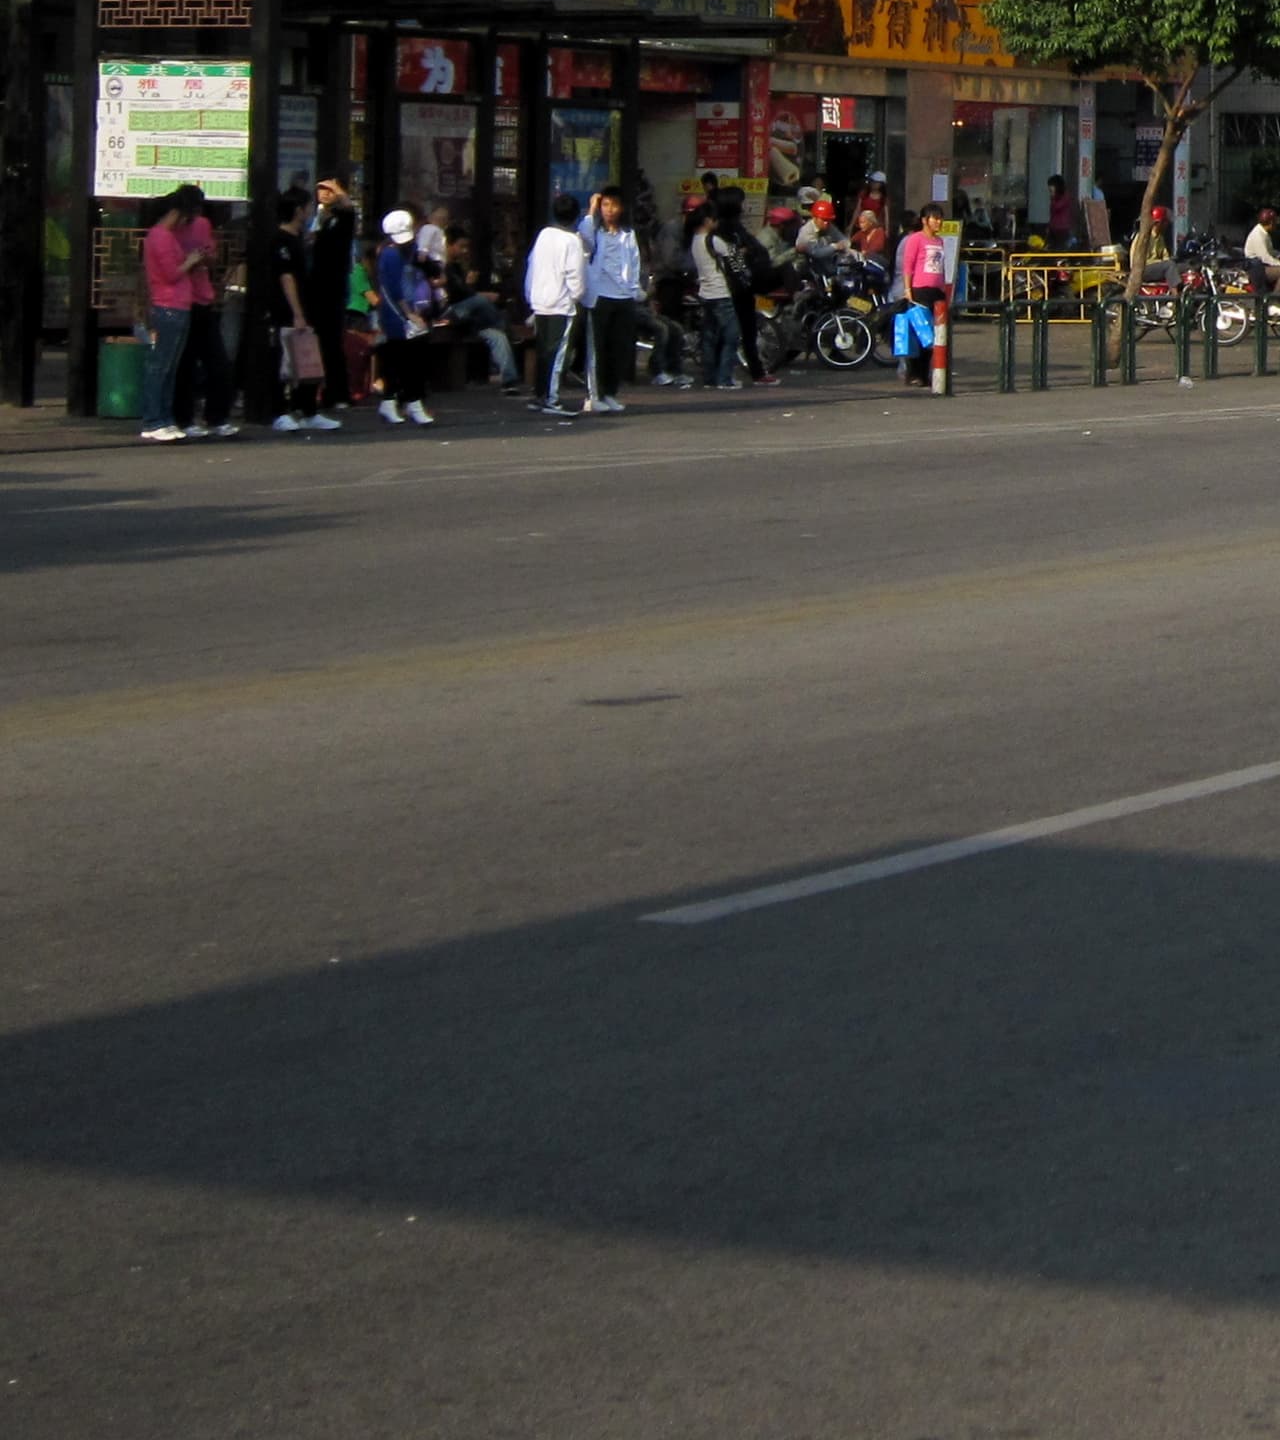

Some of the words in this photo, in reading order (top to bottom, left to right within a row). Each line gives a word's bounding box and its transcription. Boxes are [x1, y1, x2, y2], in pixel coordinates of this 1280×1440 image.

[107, 65, 246, 77] 公共汽车
[106, 102, 123, 113] 11
[108, 136, 125, 149] 66
